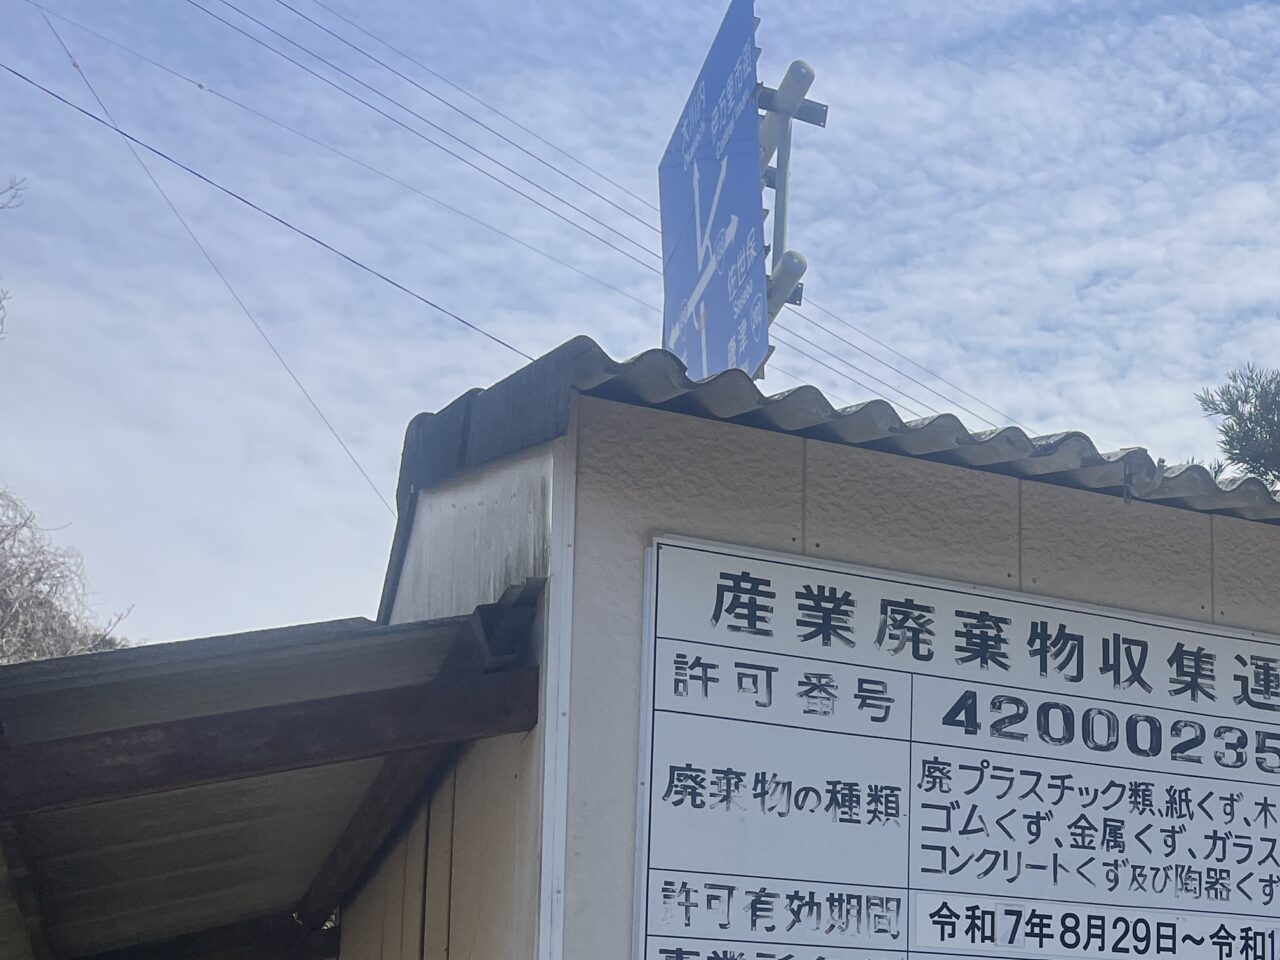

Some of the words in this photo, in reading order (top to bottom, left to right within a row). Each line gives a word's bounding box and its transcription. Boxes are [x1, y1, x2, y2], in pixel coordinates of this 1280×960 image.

[673, 653, 897, 723] 許可番号
[662, 763, 903, 828] 廃棄物の種類
[661, 879, 903, 939] 許可有効期間
